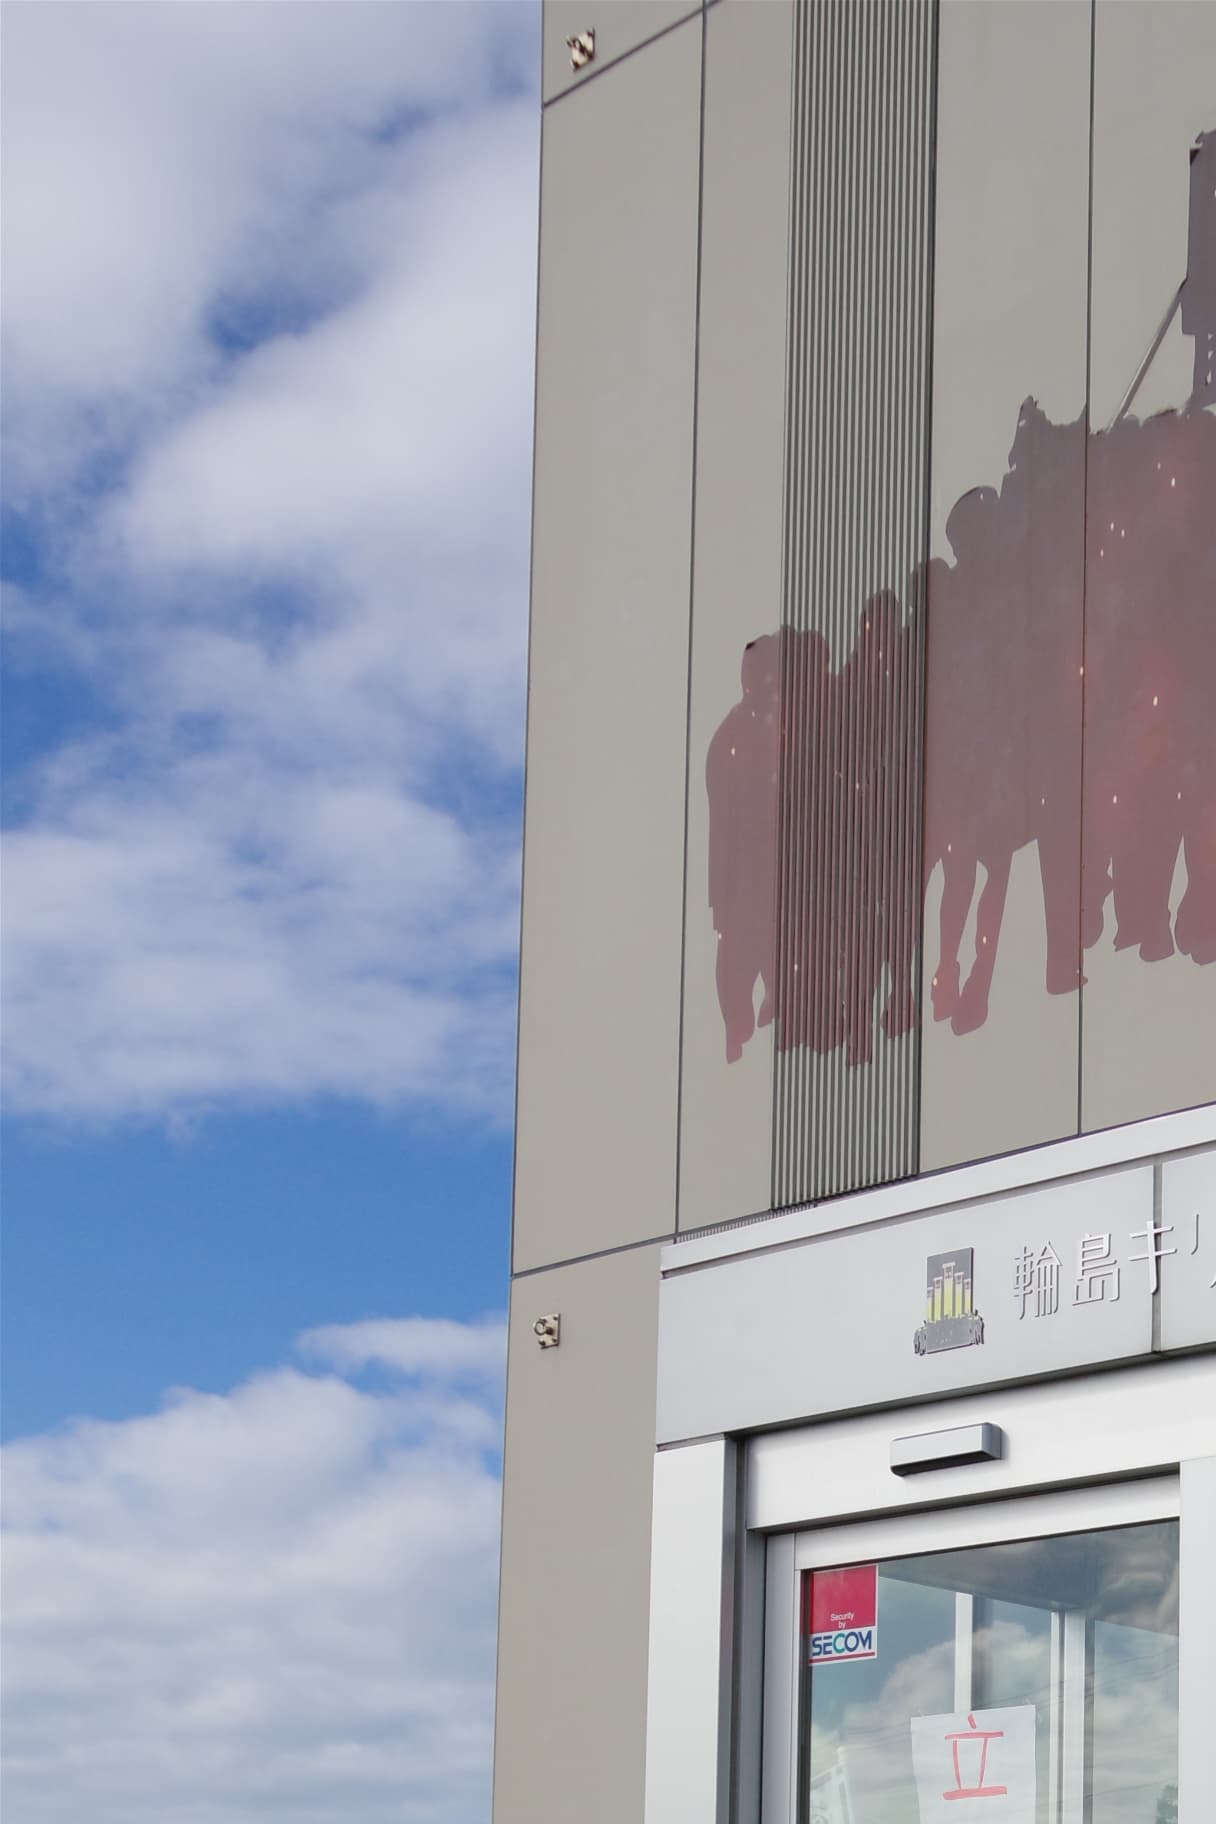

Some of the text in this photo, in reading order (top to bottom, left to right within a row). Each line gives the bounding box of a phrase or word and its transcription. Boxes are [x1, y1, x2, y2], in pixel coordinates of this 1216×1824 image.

[830, 1611, 855, 1623] Security
[838, 1620, 847, 1629] by
[811, 1630, 873, 1658] SECOM
